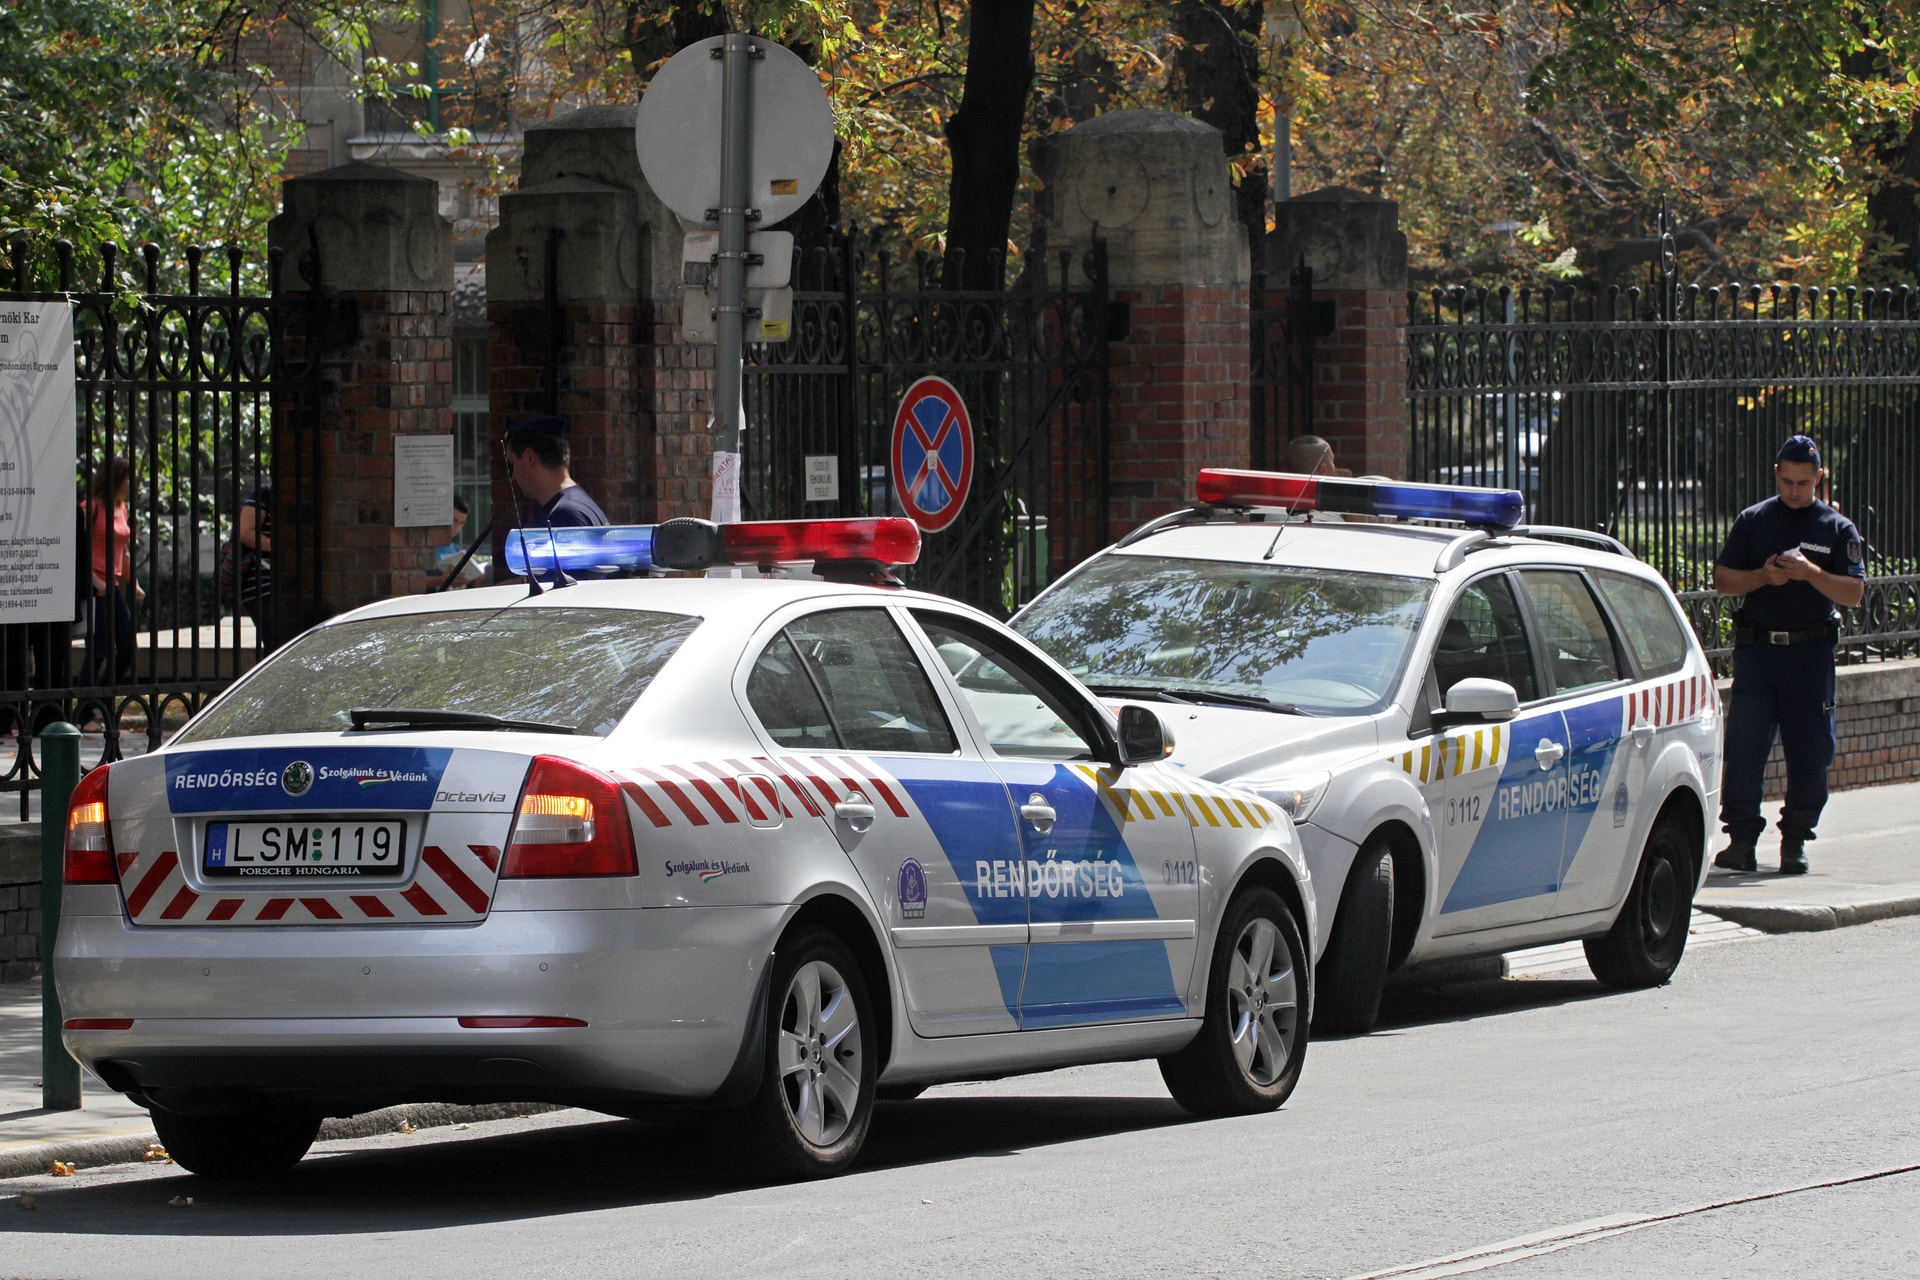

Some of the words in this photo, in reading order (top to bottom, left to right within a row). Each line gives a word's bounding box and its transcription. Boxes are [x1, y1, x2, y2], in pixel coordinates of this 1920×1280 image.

[23, 311, 40, 324] Kar
[33, 361, 58, 372] Egyetem
[35, 562, 59, 570] csatorna
[175, 768, 278, 789] RENDŐRSÉG
[318, 766, 375, 780] Szolgálunk
[376, 768, 388, 778] és
[389, 769, 428, 783] Védünk
[434, 791, 506, 803] Octavia
[1498, 763, 1600, 821] RENDŐRSÉG
[1459, 796, 1480, 824] 112
[212, 848, 222, 861] H
[239, 867, 291, 875] PORSCHE
[295, 866, 361, 875] HUNGARIA
[665, 859, 710, 877] Szolgálunk
[711, 859, 720, 870] és
[720, 860, 750, 875] Védünk
[975, 849, 1124, 899] RENDŐRSÉG
[1174, 860, 1195, 884] 112
